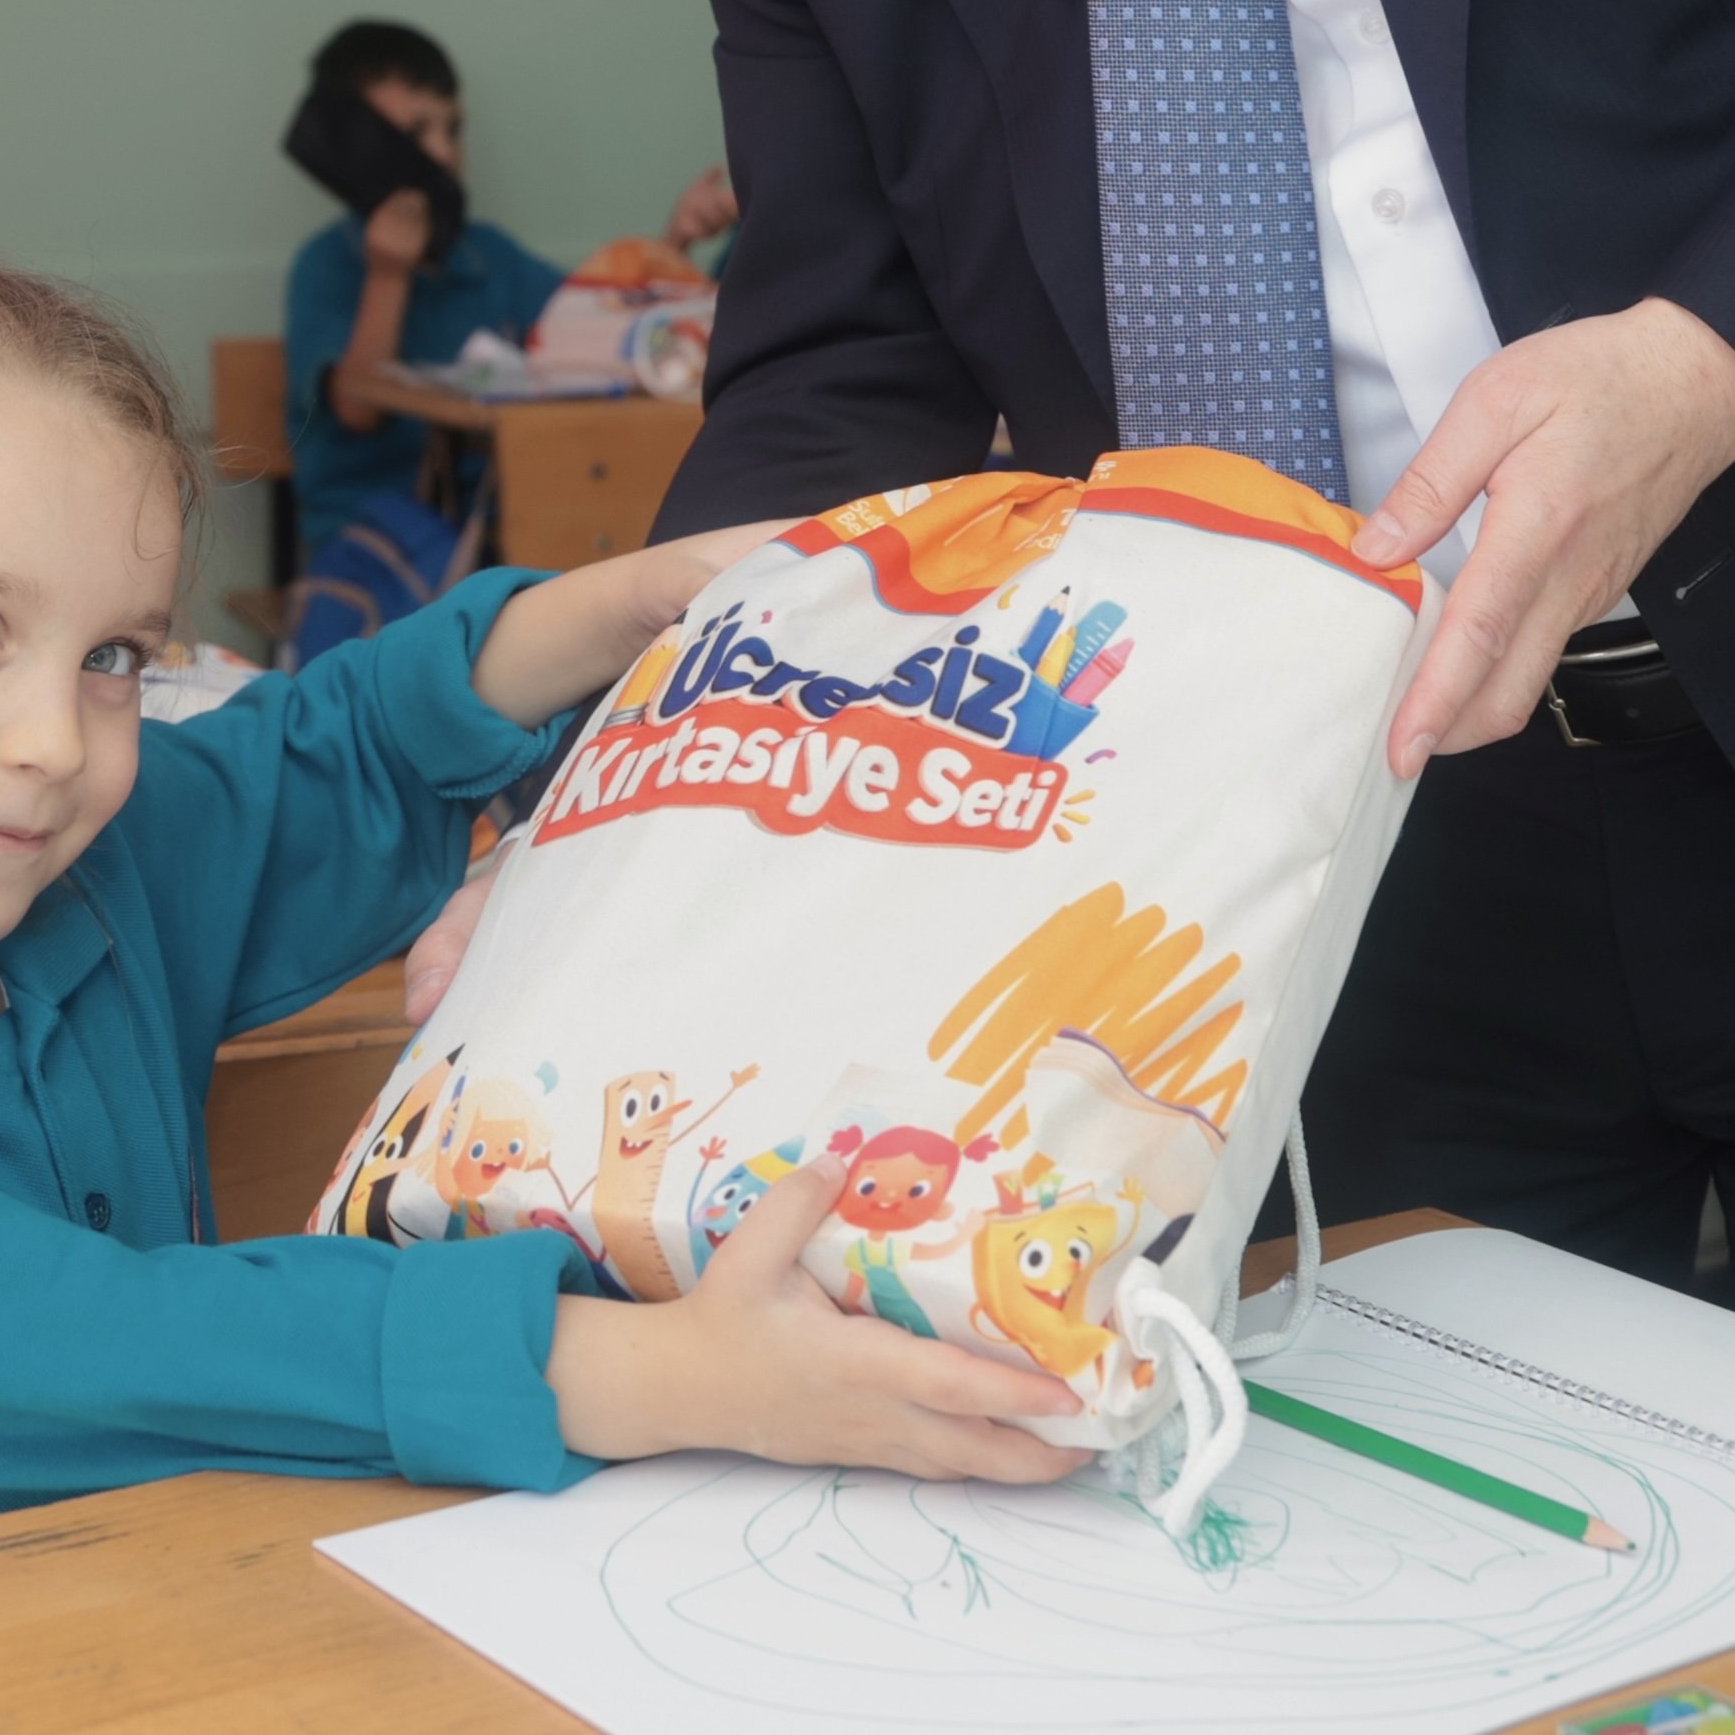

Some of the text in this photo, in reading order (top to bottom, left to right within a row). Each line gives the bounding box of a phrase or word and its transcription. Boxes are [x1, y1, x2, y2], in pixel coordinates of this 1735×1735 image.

[659, 600, 1025, 740] Ücresiz
[549, 716, 1058, 832] Kırtasiye Seti
